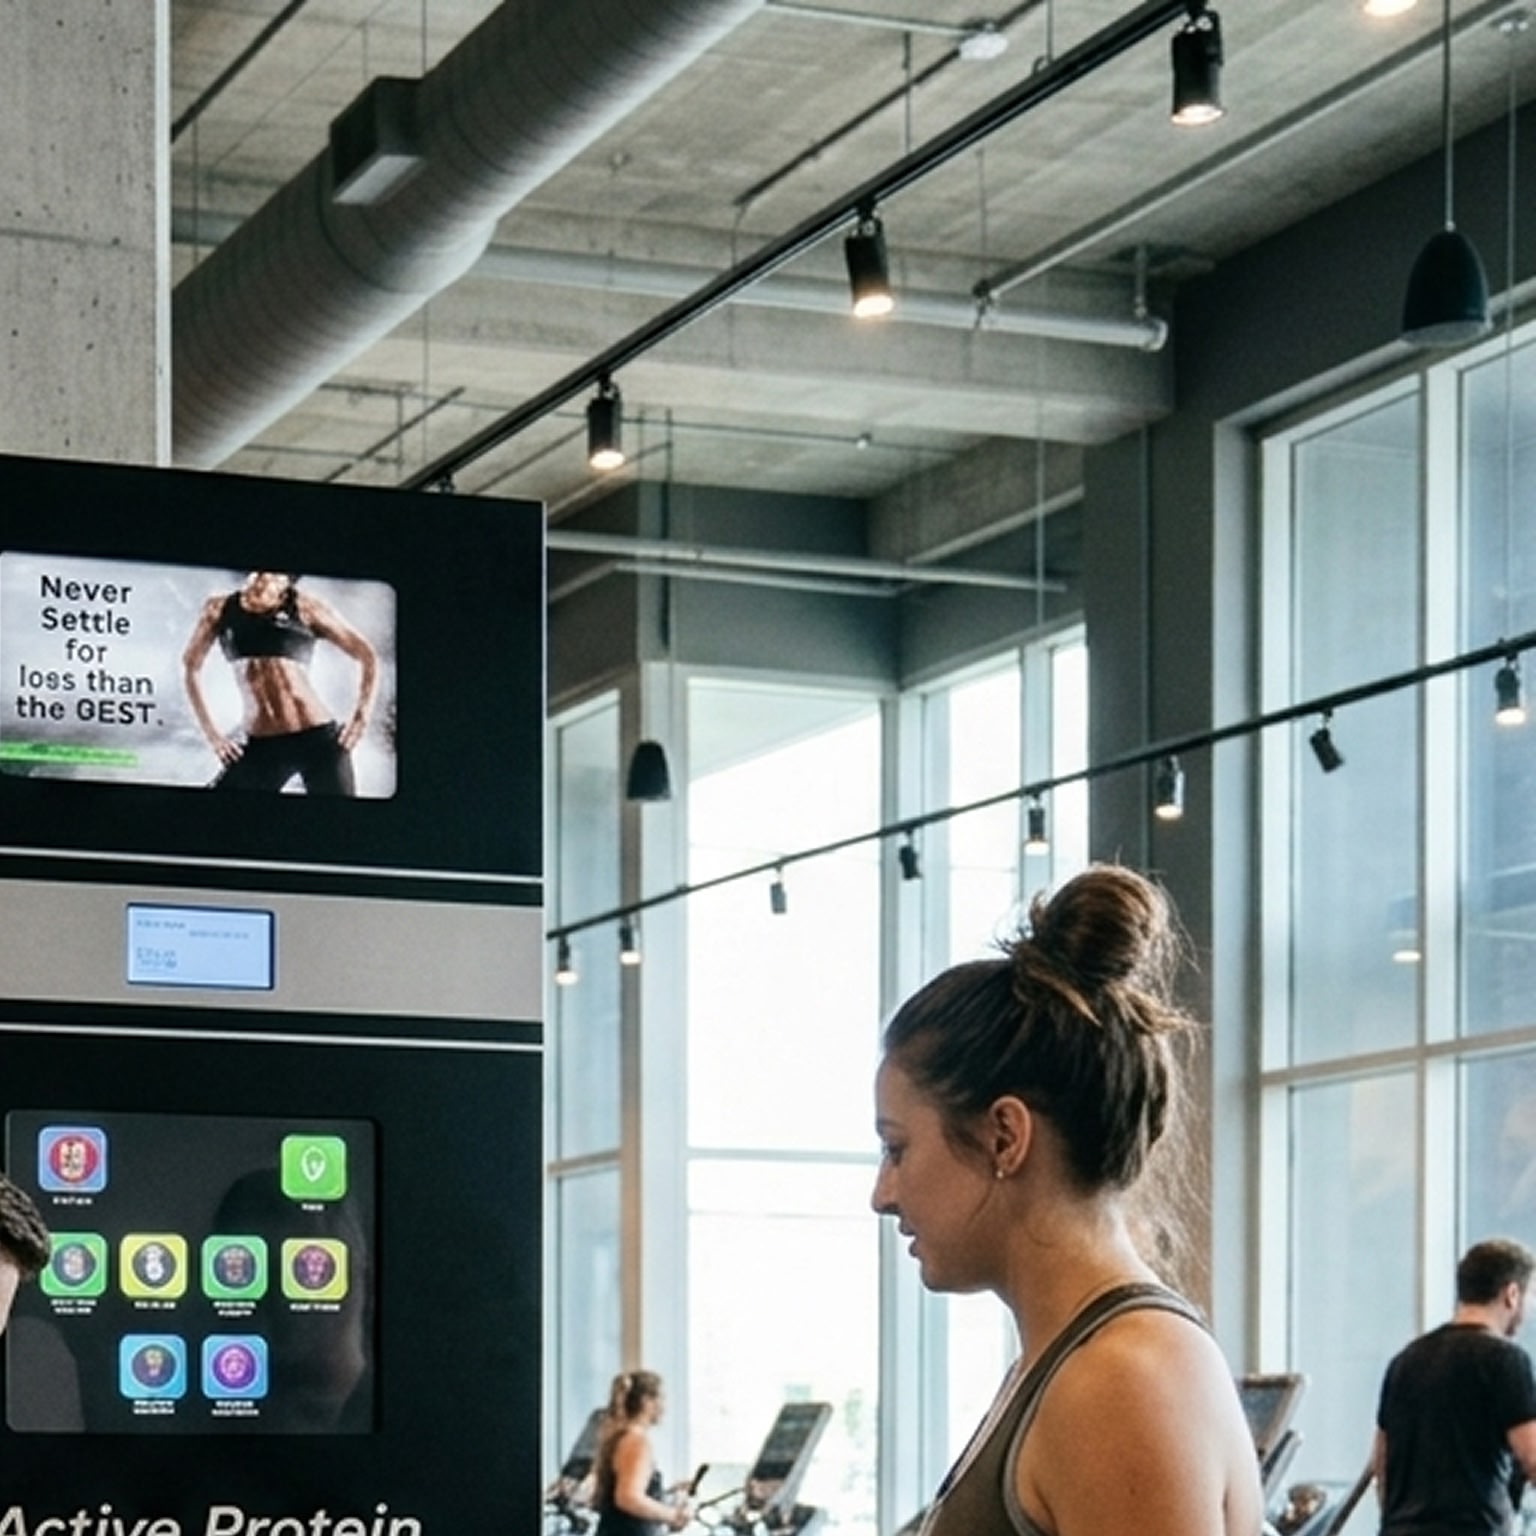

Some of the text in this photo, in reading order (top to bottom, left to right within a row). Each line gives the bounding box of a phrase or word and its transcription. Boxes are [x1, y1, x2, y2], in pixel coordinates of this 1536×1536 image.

[41, 574, 132, 604] Never
[41, 606, 130, 635] Settle
[65, 638, 107, 663] for
[87, 669, 153, 694] than
[16, 695, 65, 720] the
